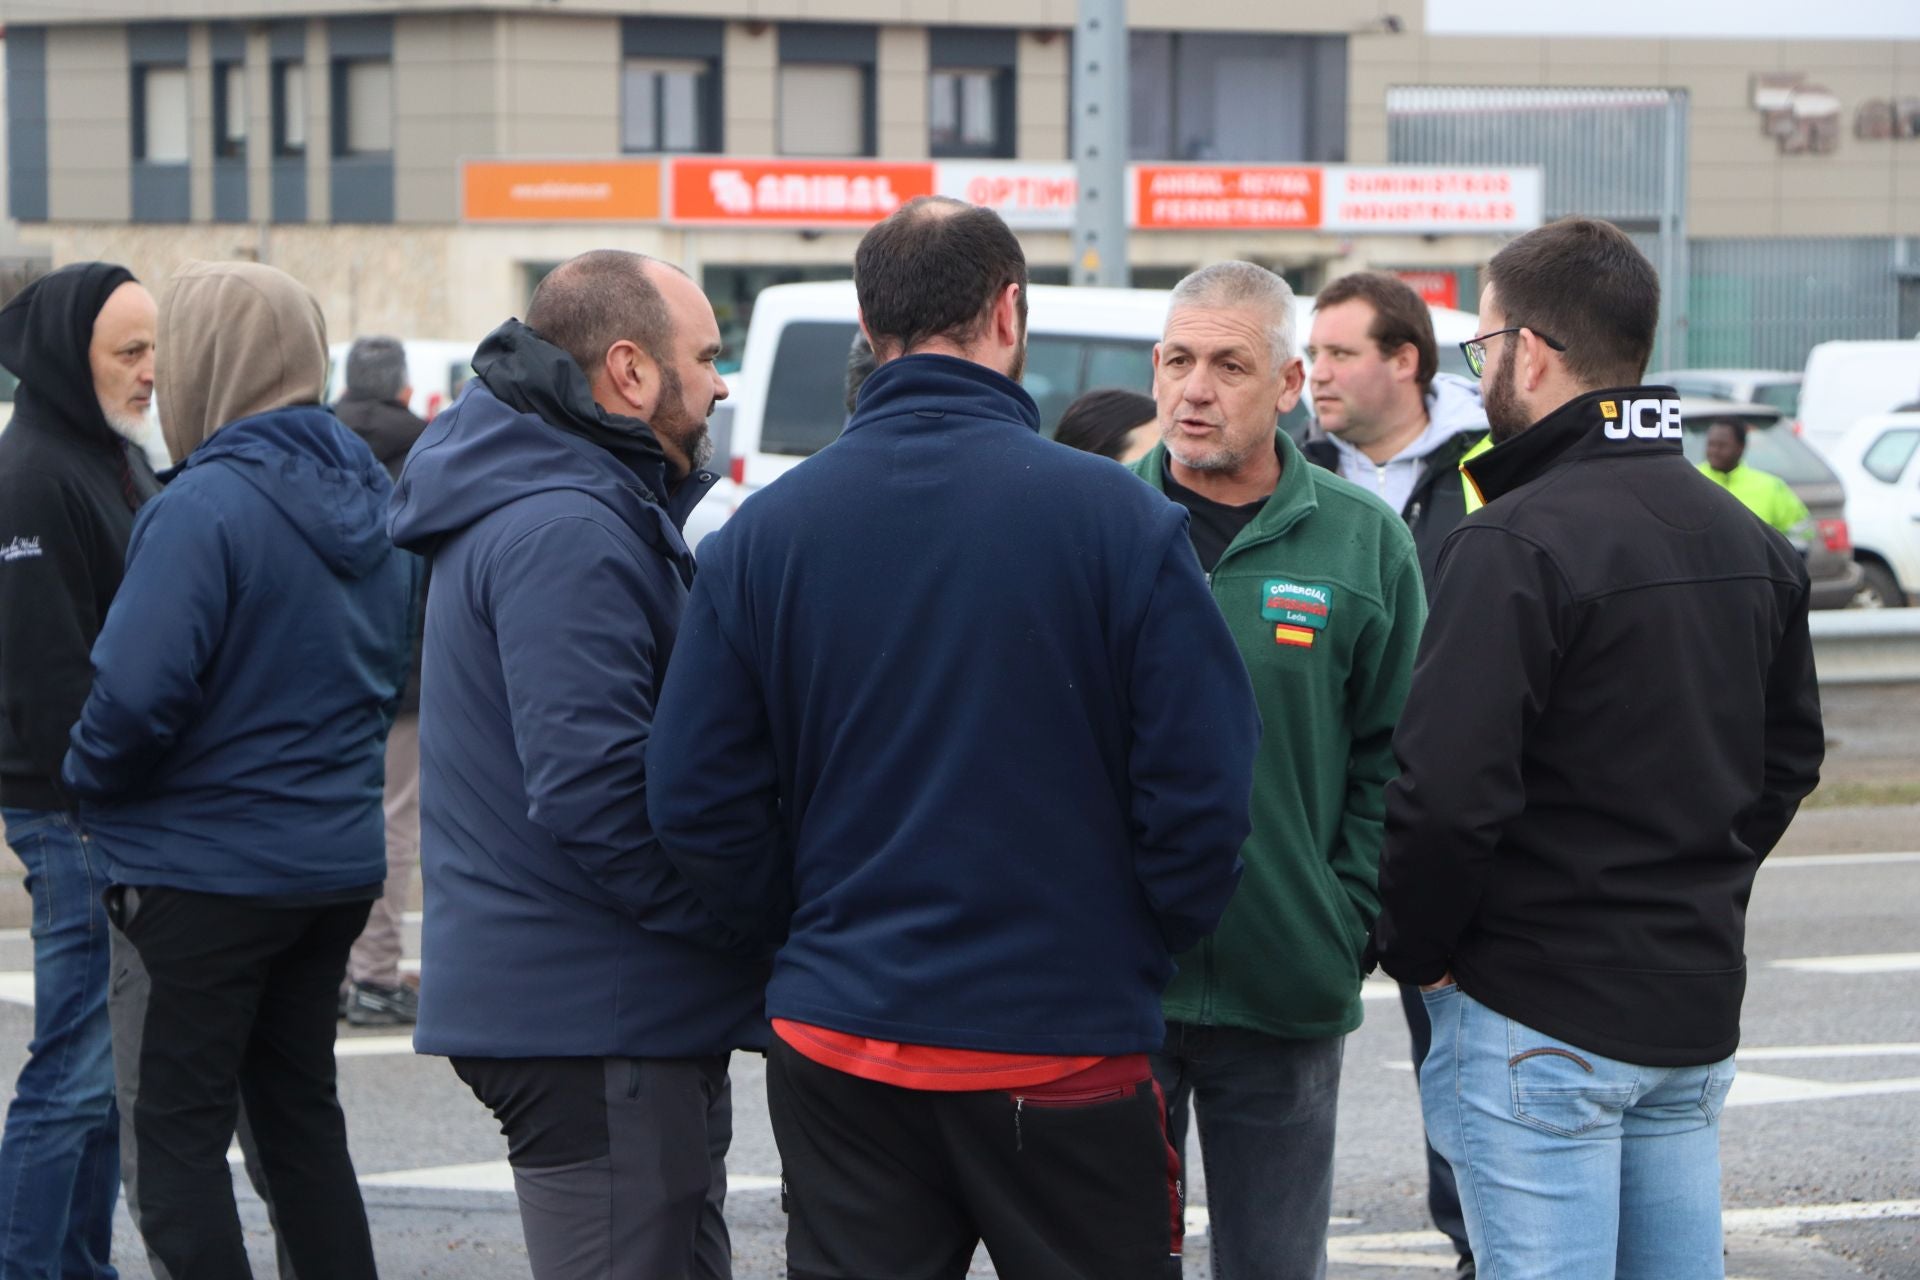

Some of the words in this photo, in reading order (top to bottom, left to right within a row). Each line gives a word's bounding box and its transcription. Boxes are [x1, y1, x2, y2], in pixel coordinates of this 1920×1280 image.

[967, 177, 1079, 208] OPTIM
[1346, 174, 1511, 193] SUMINISTROS
[1340, 203, 1515, 222] INDUSTRIALES
[1604, 399, 1682, 439] JCB
[1271, 584, 1326, 603] COMERCIAL
